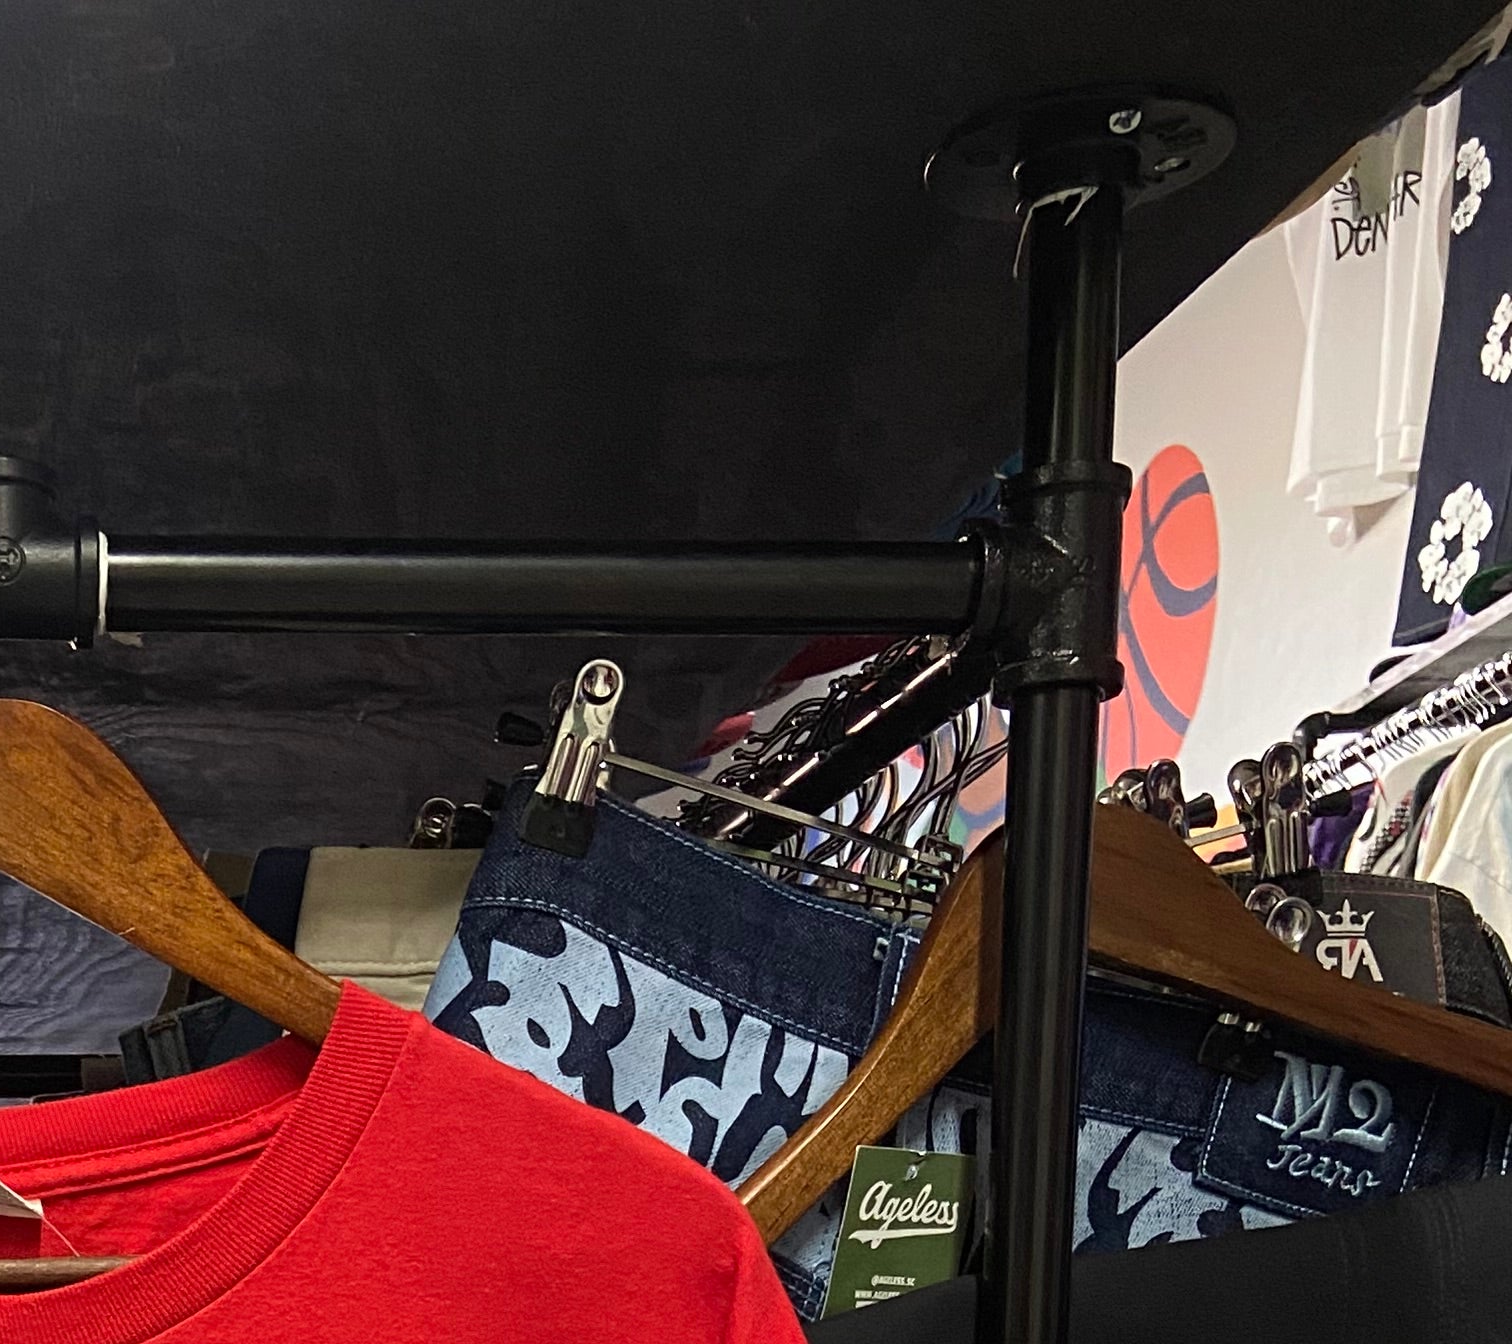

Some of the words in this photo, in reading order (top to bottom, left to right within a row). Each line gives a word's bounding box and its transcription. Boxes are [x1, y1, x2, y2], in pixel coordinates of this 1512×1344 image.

[1256, 1051, 1393, 1152] M2
[1266, 1144, 1381, 1196] Jeans
[858, 1180, 959, 1250] Ageless
